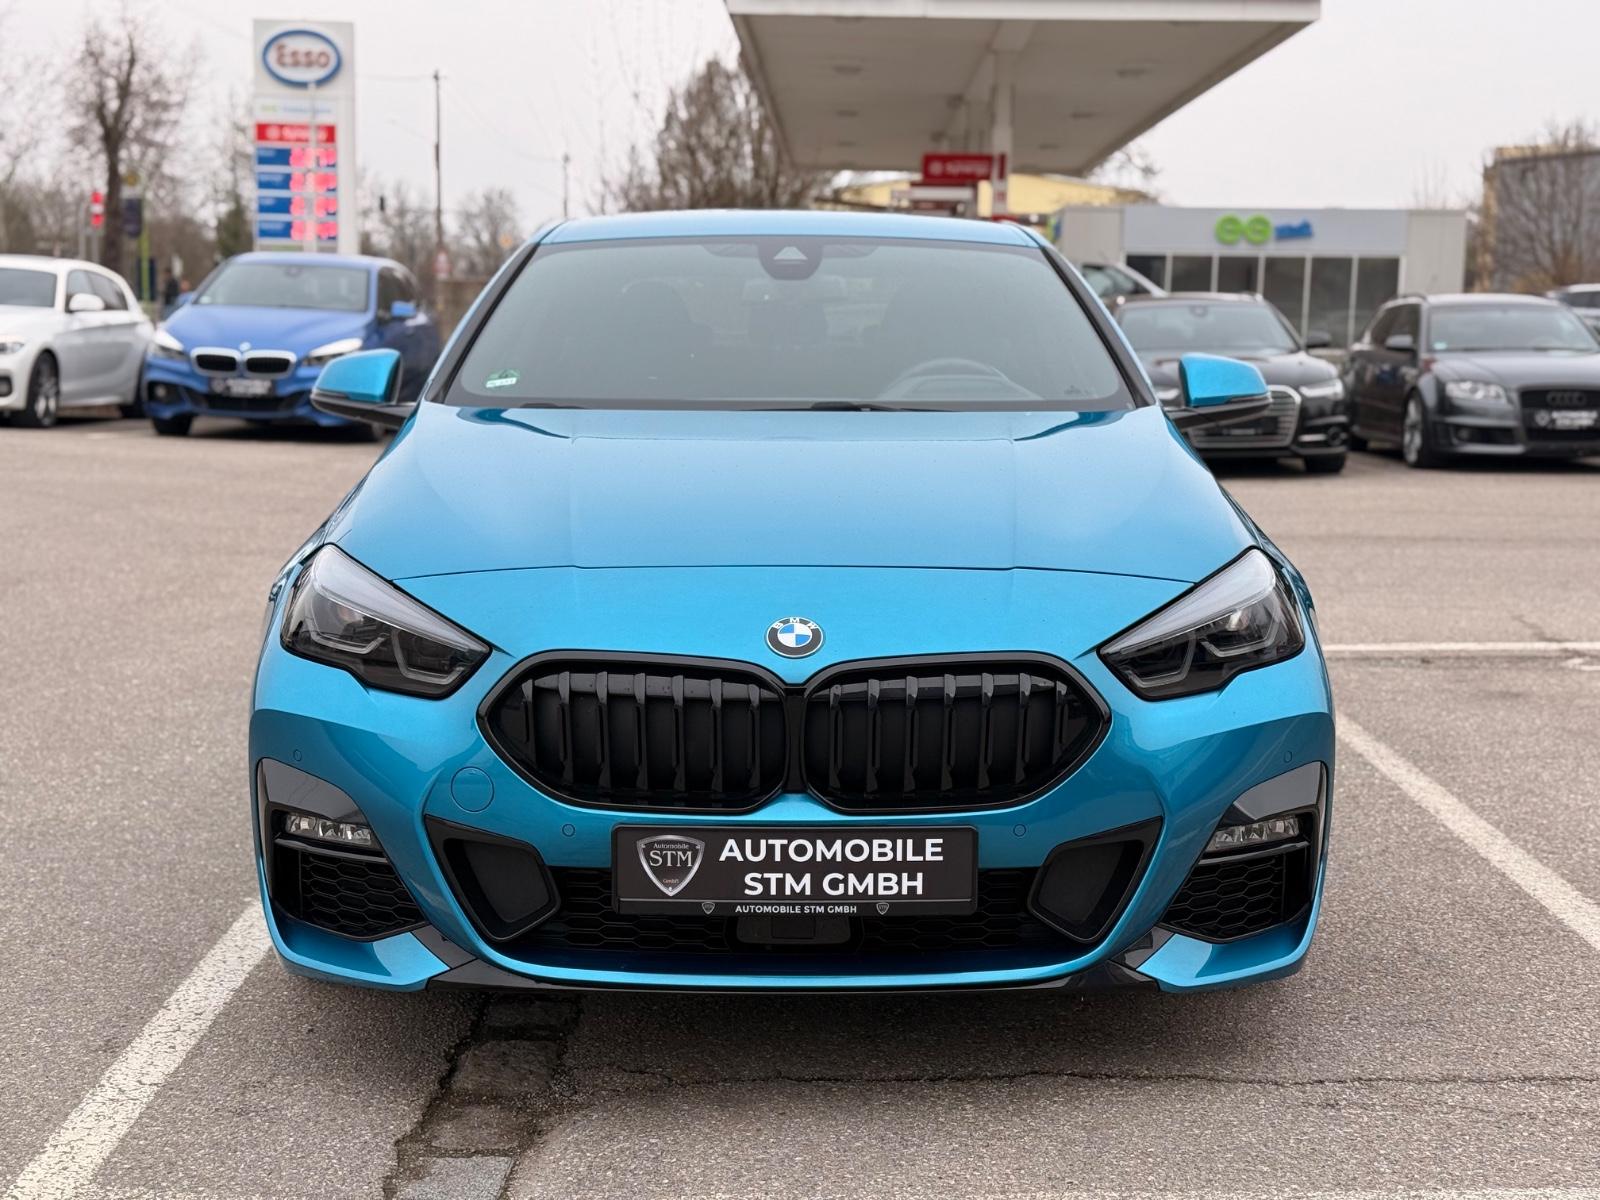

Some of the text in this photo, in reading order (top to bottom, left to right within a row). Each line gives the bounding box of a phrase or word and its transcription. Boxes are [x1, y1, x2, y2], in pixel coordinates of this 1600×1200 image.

[274, 43, 331, 69] Esso
[772, 617, 818, 629] BMW
[649, 850, 693, 867] STM
[719, 838, 944, 862] AUTOMOBILE
[744, 872, 923, 896] STM GMBH
[735, 905, 857, 914] AUTOMOBILE STM GMBH
